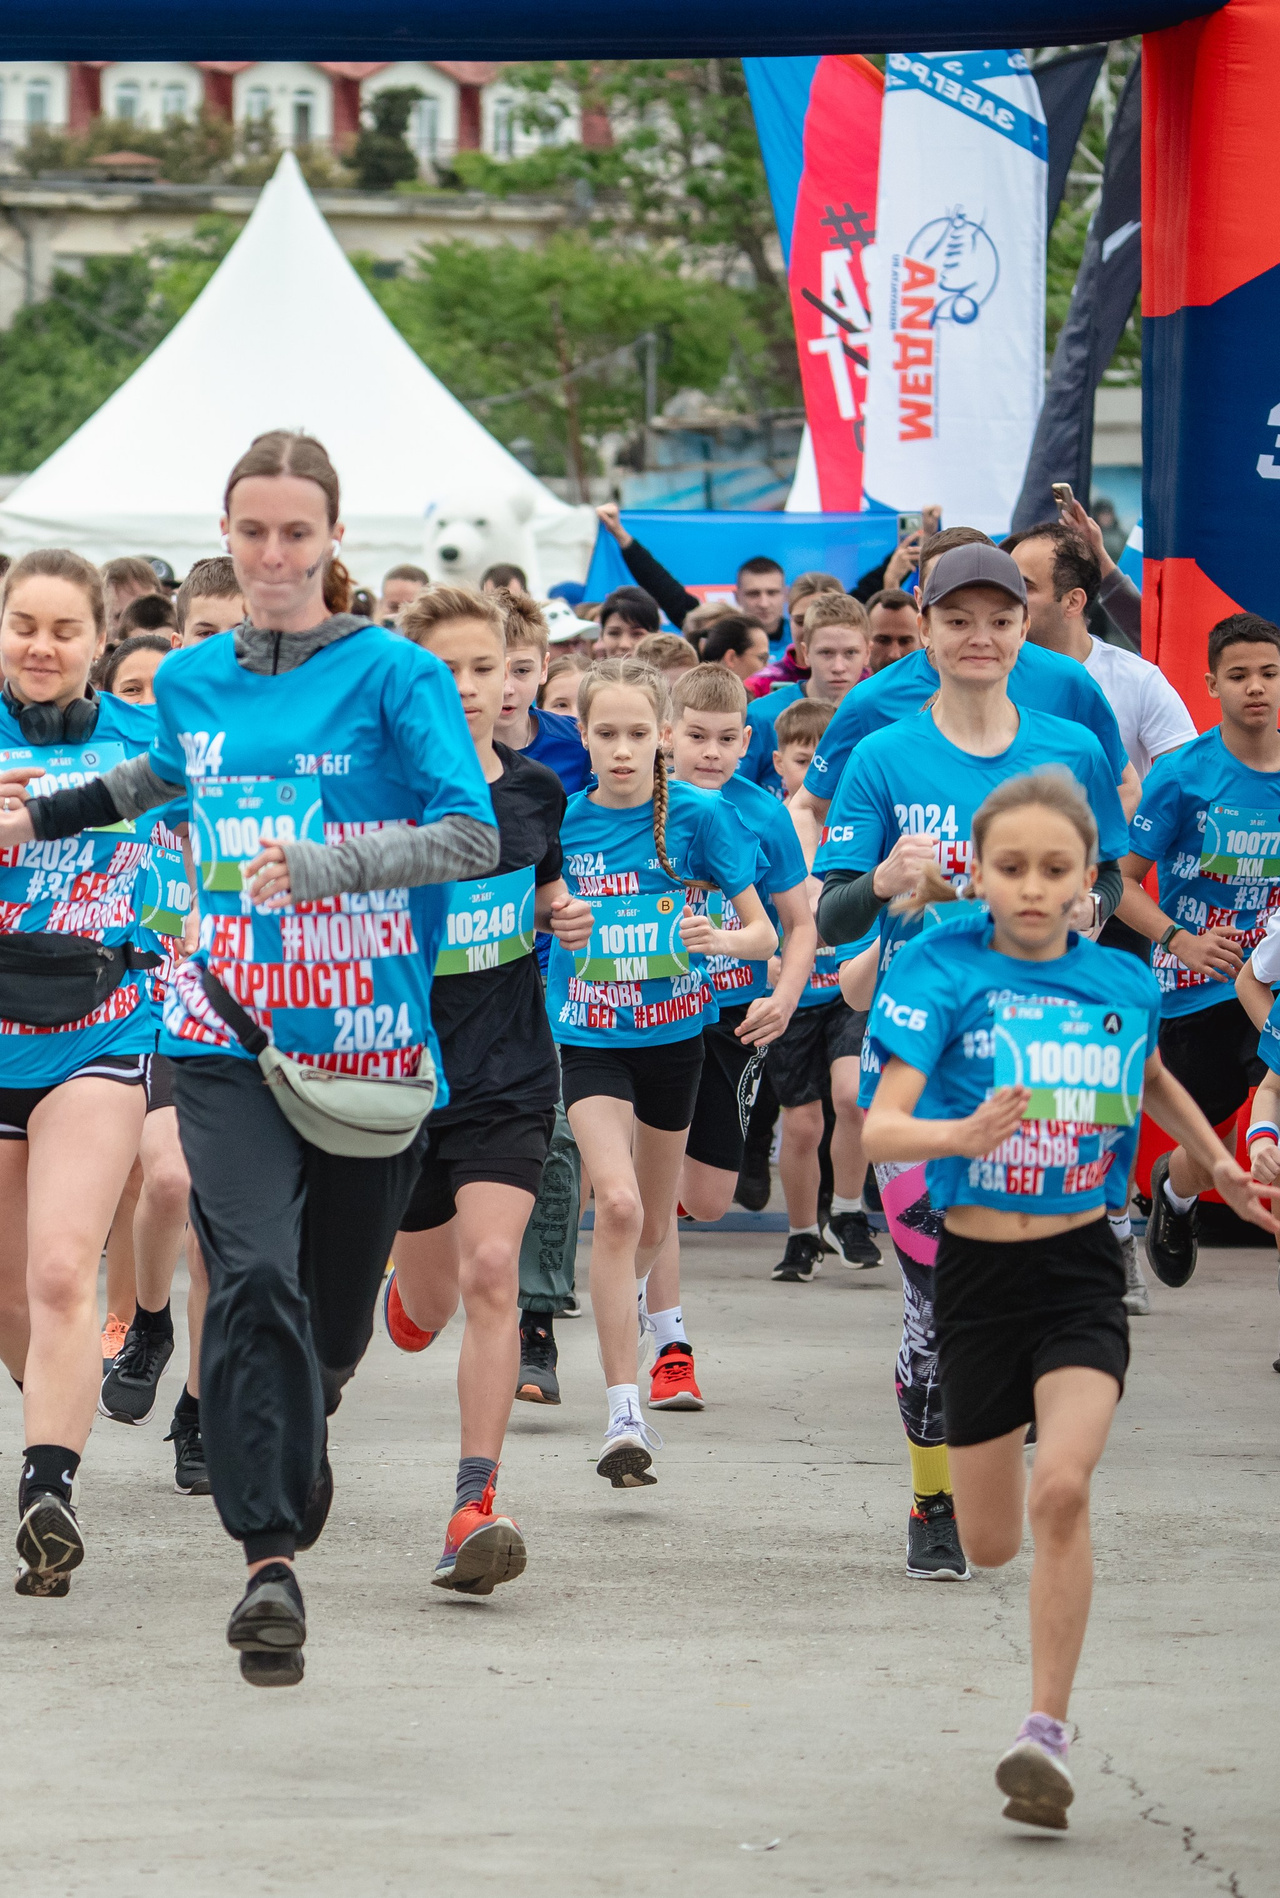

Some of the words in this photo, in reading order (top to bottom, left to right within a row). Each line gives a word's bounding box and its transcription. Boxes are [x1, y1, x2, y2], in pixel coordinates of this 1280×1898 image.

[812, 752, 830, 773] СБ
[894, 803, 958, 840] 2024
[1133, 814, 1154, 832] СБ
[1224, 808, 1239, 817] ПСБ
[215, 814, 295, 858] 10048
[1226, 829, 1280, 855] 10077
[165, 853, 181, 864] ПСБ
[565, 851, 606, 876] 2024
[648, 857, 678, 870] ЗАЕГ
[1236, 857, 1265, 877] 1KM
[446, 902, 516, 945] 10246
[599, 922, 659, 955] 10117
[466, 941, 499, 972] 1KM
[613, 956, 648, 981] 1KM
[333, 1002, 413, 1052] 2024
[559, 1001, 617, 1029] #ЗАБЕГ
[877, 992, 929, 1032] ПСБ
[1026, 1040, 1122, 1088] 10008
[1053, 1087, 1097, 1123] 1KM
[968, 1161, 1045, 1196] #ЗАБЕГ
